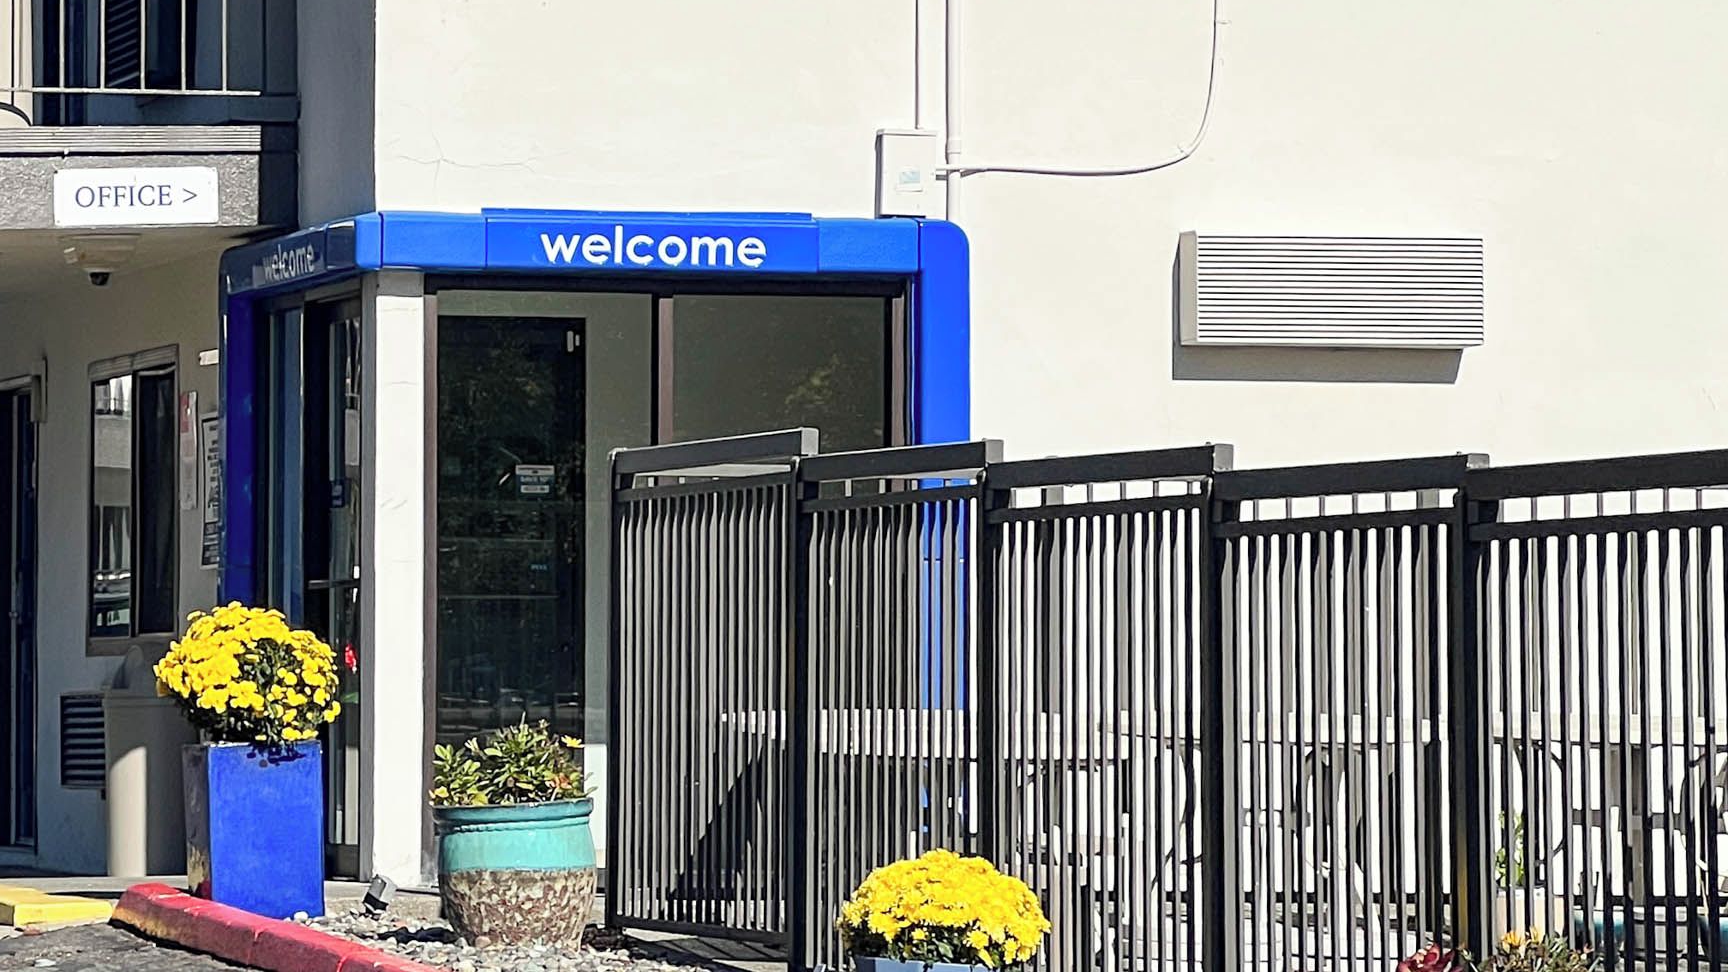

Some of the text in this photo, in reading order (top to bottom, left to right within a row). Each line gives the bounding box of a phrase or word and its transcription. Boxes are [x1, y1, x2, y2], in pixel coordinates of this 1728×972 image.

[75, 185, 173, 208] OFFICE
[263, 244, 315, 282] welcome
[540, 225, 767, 268] welcome
